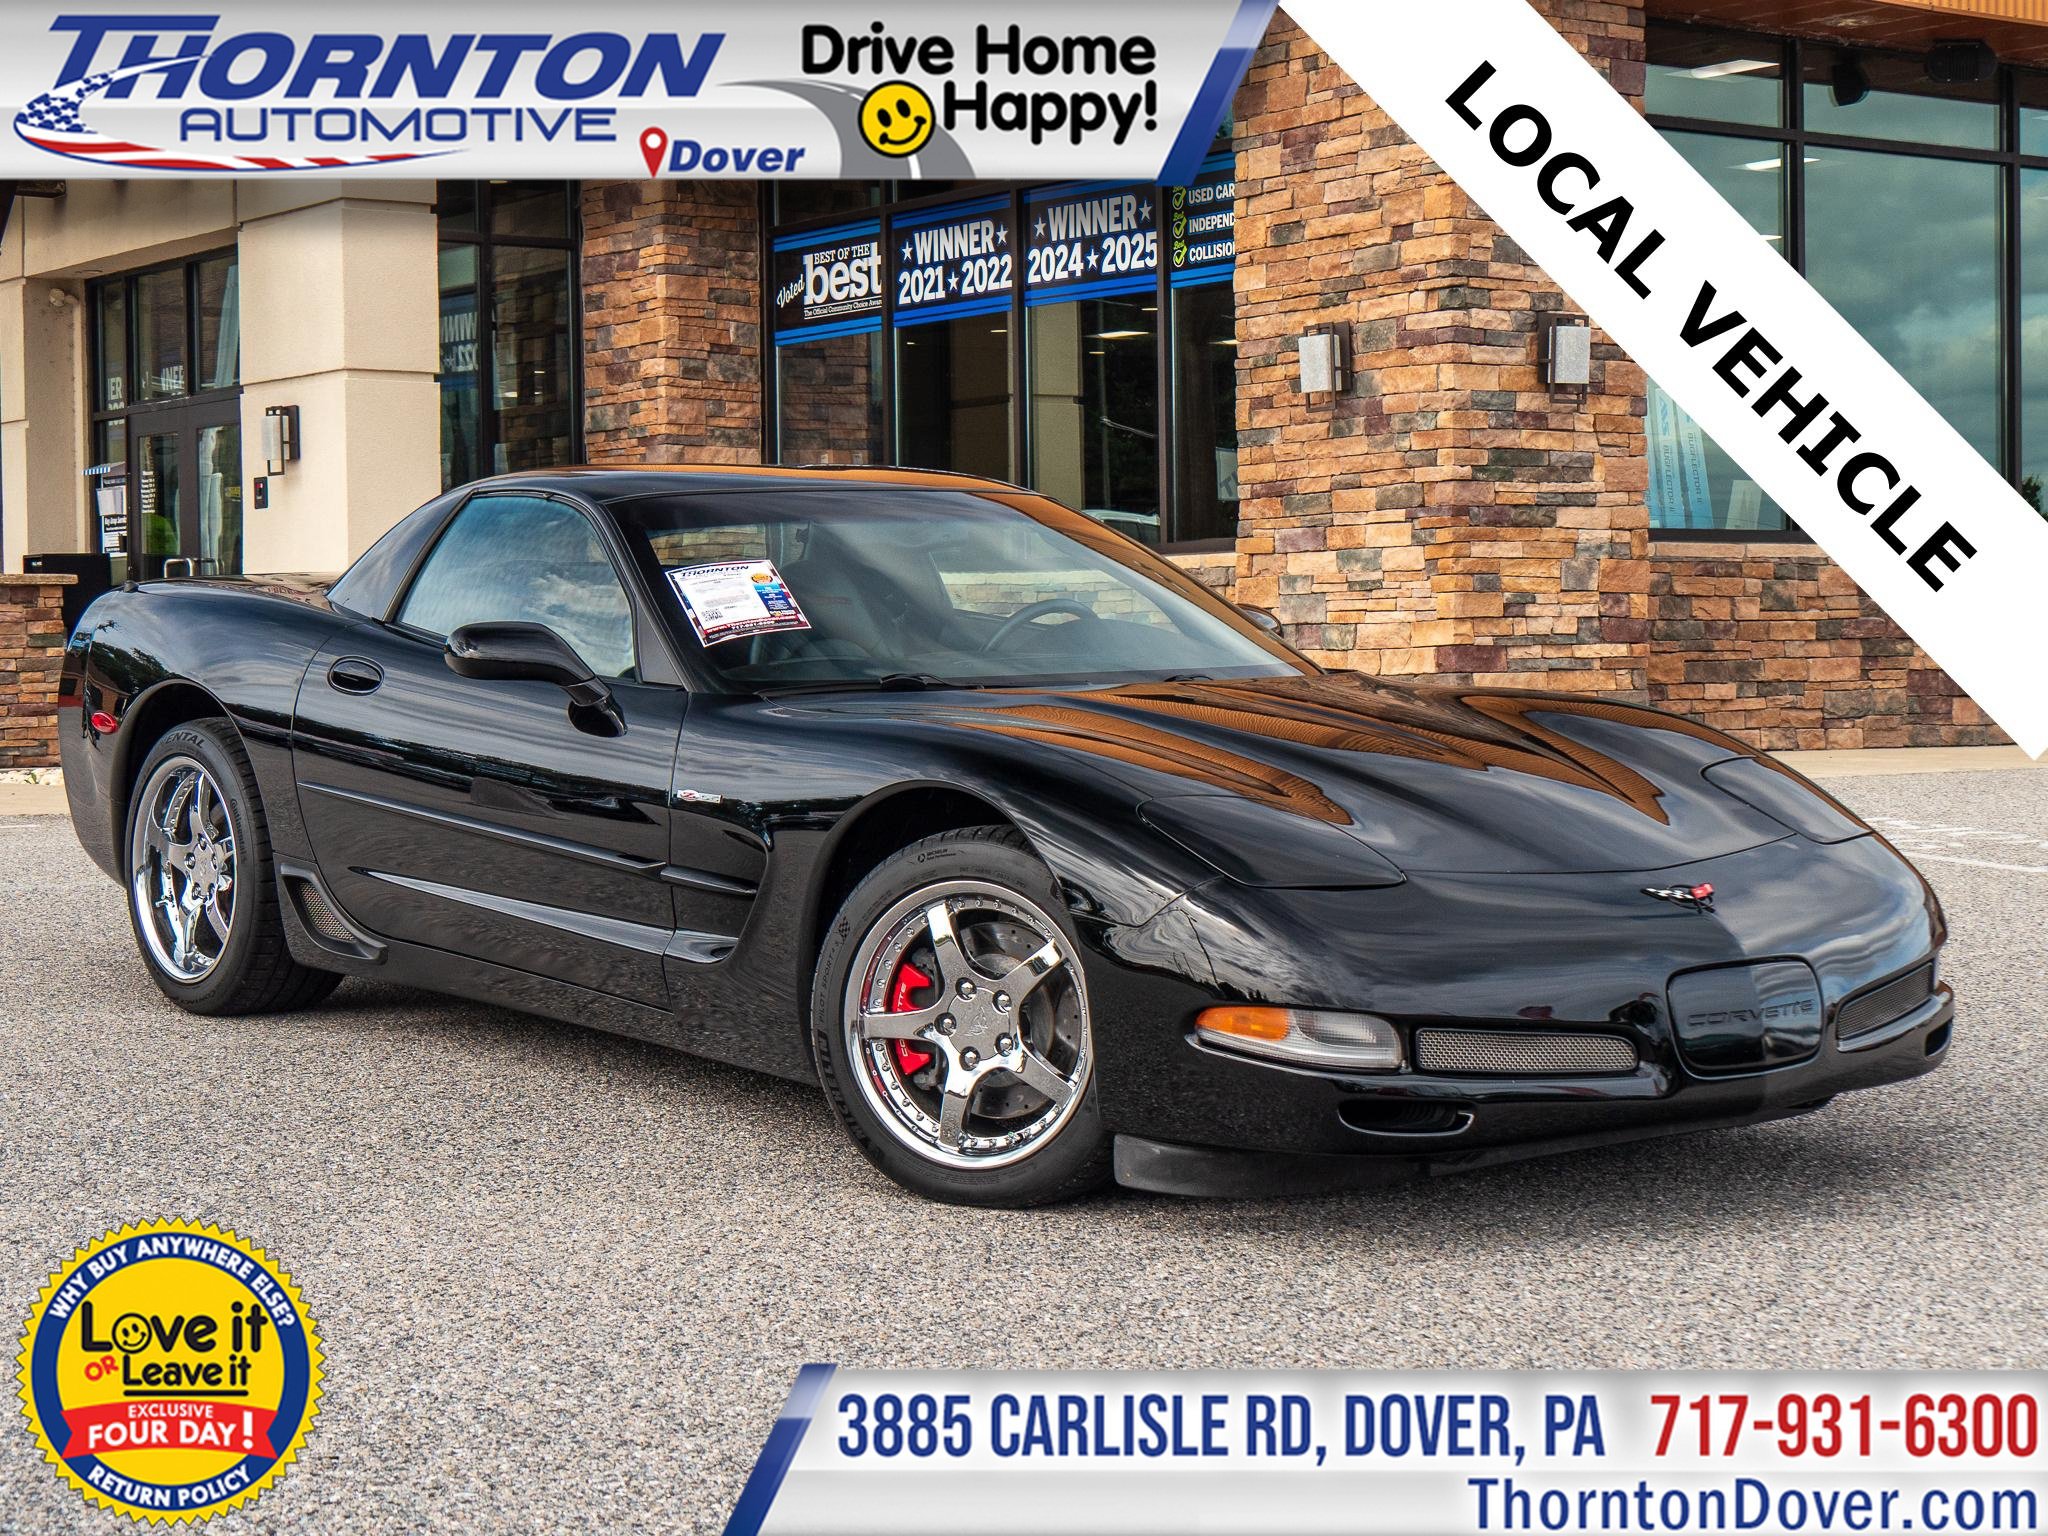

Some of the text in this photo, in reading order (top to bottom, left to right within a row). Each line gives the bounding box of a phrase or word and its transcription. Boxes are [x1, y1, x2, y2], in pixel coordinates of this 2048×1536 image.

[1188, 187, 1213, 204] USED
[1215, 183, 1235, 200] CAR
[1048, 194, 1137, 242] WINNER
[813, 243, 870, 265] BEST OF THE
[914, 219, 995, 265] WINNER
[1028, 231, 1158, 284] 2024 2025
[776, 274, 805, 308] Voted
[803, 241, 882, 305] best
[899, 254, 1013, 305] 2021 2022
[1687, 998, 1815, 1026] CORVETTE
